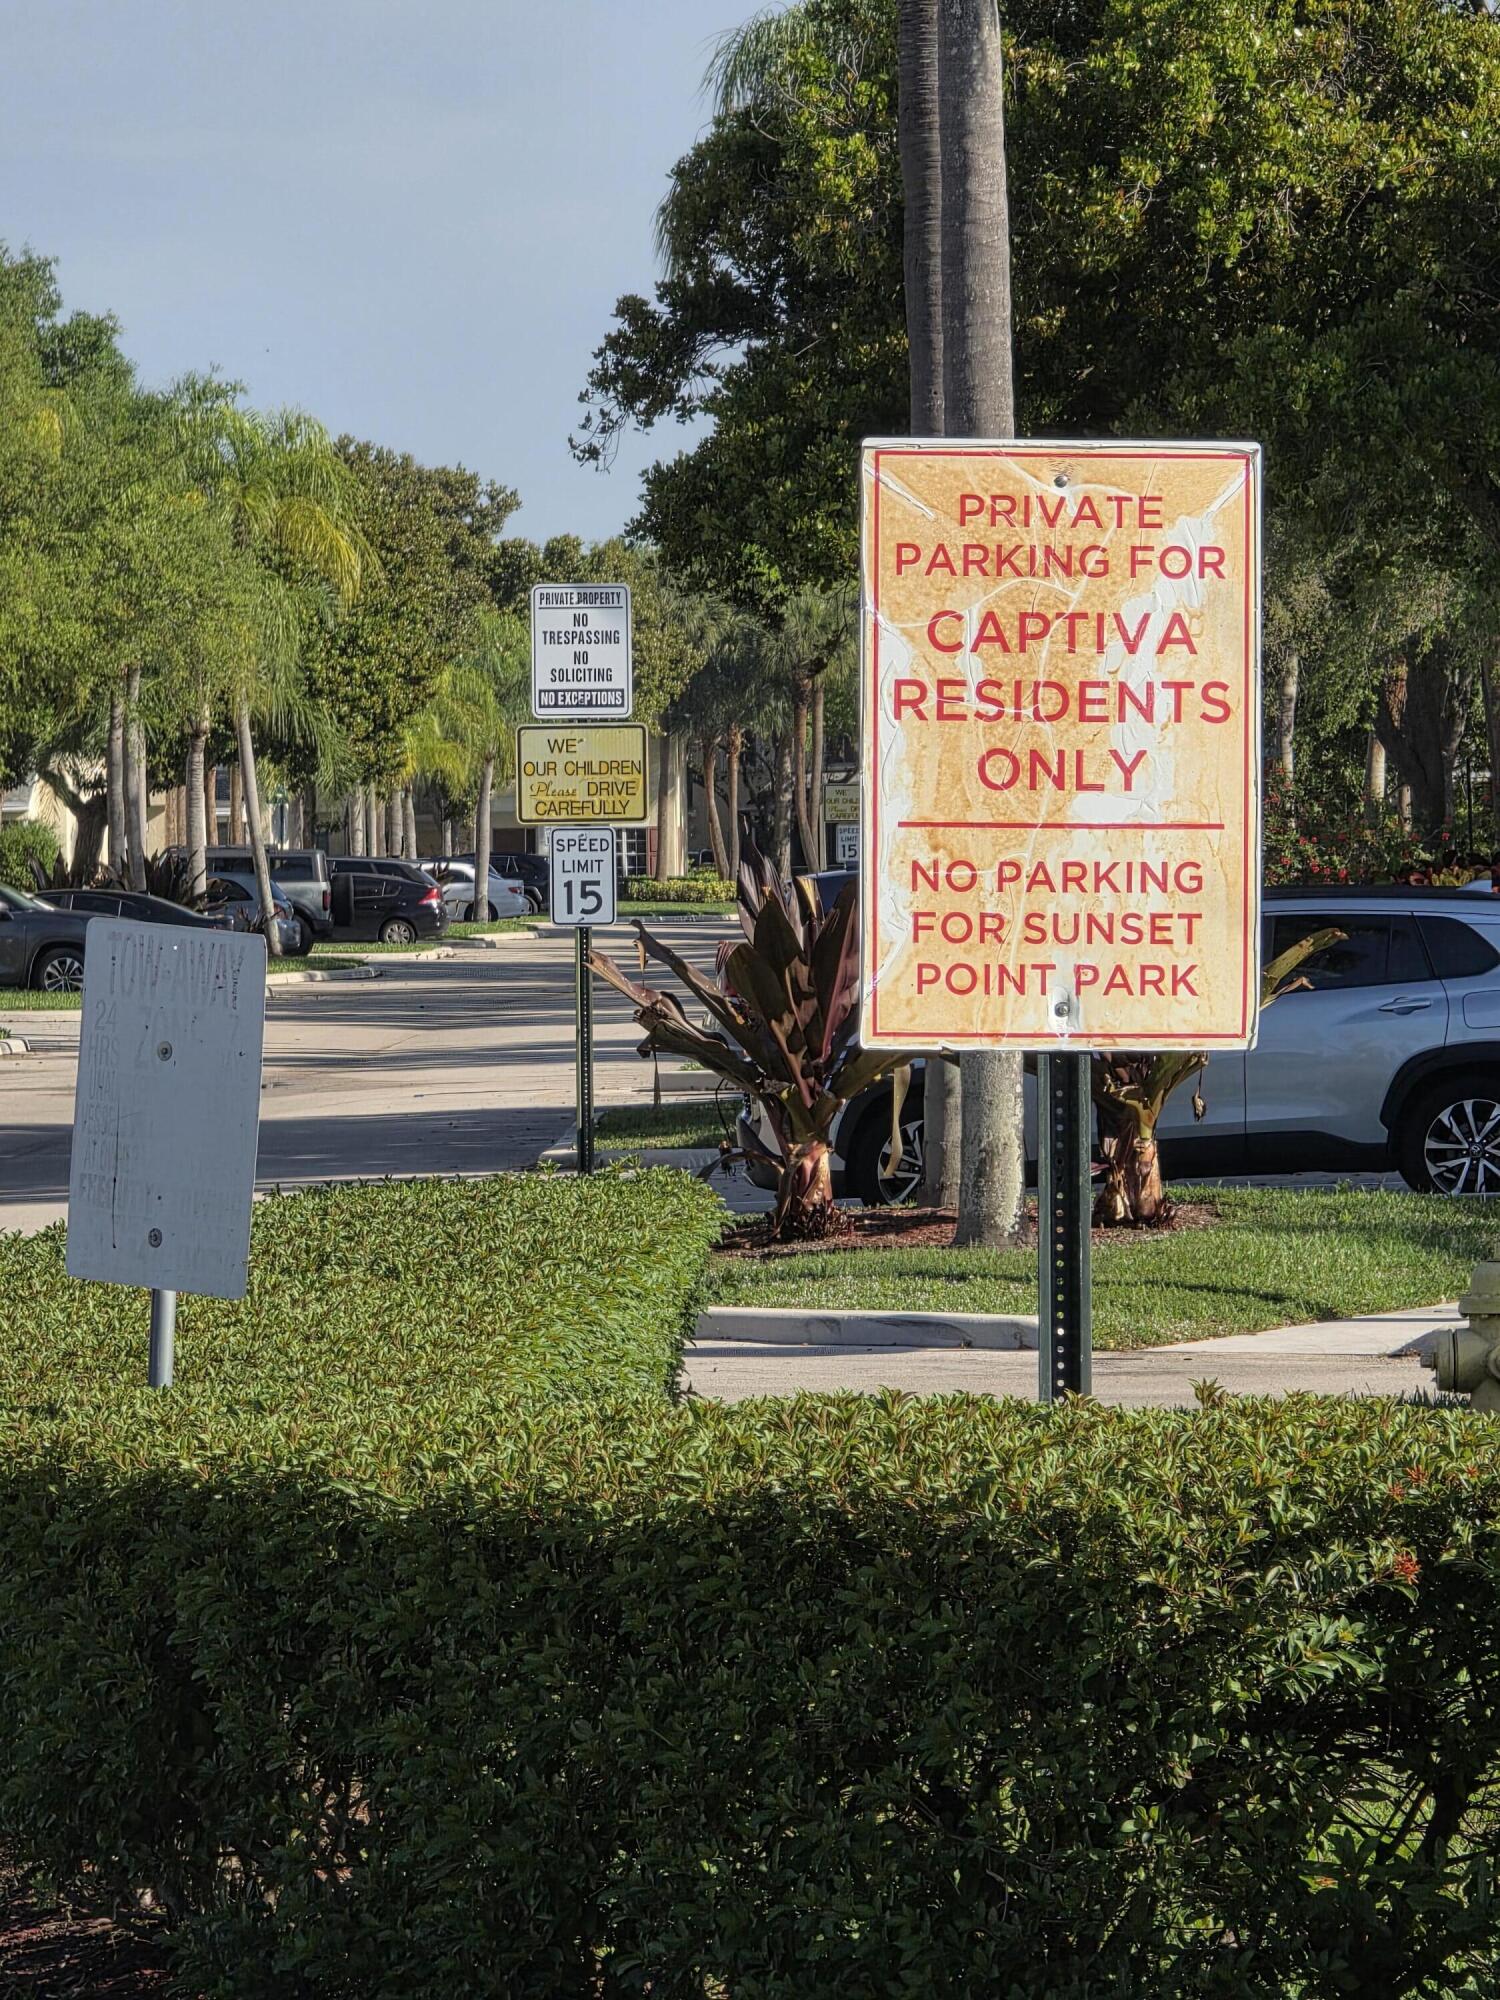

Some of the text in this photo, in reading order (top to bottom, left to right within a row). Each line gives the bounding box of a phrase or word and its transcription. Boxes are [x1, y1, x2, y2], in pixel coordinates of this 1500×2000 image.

[959, 494, 1163, 529] PRIVATE
[895, 543, 1226, 579] PARKING FOR
[539, 591, 621, 605] PRIVATE PROPERTY
[573, 613, 588, 627] NO
[542, 630, 620, 645] TRESPASSING
[927, 610, 1197, 655] CAPTIVA
[573, 650, 589, 665] NO
[550, 667, 613, 682] SOLICITING
[540, 691, 622, 705] NO EXCEPTIONS
[893, 678, 1231, 724] RESIDENTS
[547, 738, 577, 753] WE
[523, 760, 642, 776] OUR CHILDREN
[977, 748, 1147, 792] ONLY
[529, 780, 637, 797] Please DRIVE
[534, 799, 630, 816] CAREFULLY
[556, 838, 610, 852] SPEED
[842, 844, 857, 858] 15
[562, 859, 604, 873] LIMIT
[911, 859, 1204, 894] NO PARKING
[563, 880, 603, 915] 15
[912, 911, 1202, 945] FOR SUNSET
[916, 963, 1199, 996] POINT PARK
[94, 1000, 117, 1032] 24
